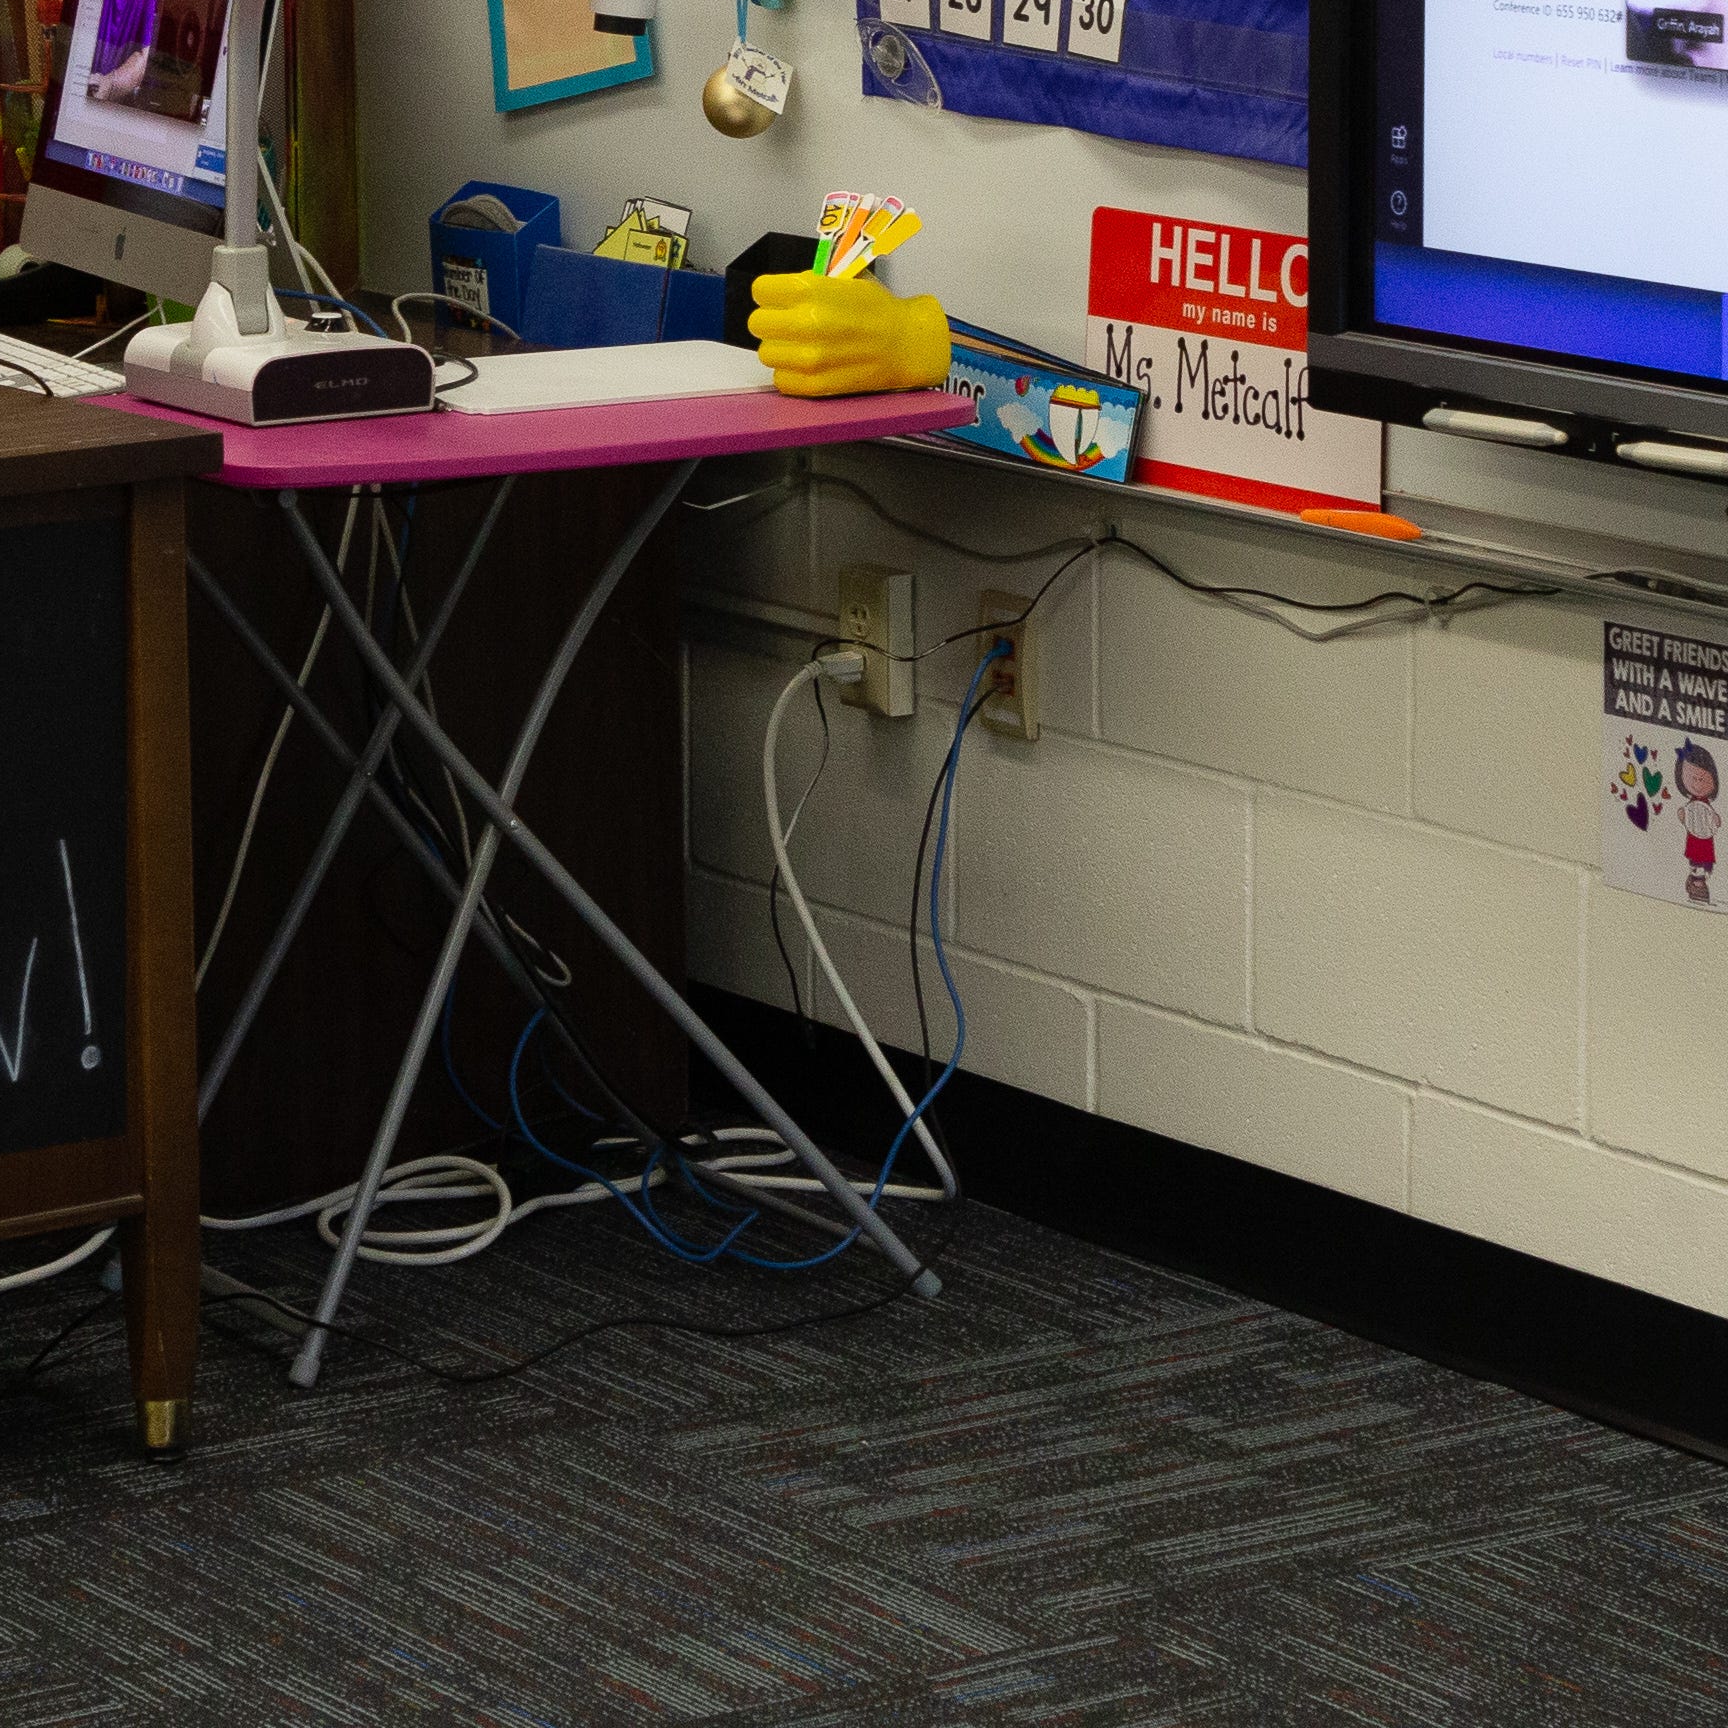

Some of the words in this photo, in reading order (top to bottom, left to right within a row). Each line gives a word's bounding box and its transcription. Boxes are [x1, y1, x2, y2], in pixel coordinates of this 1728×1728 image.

[1182, 300, 1207, 325] my
[1212, 308, 1255, 330] name
[1262, 311, 1277, 330] is
[313, 376, 369, 389] ELMO
[1106, 323, 1162, 410] Ms.
[1174, 337, 1311, 441] Metcalf
[1609, 627, 1659, 651] GREET
[1612, 658, 1654, 686] WITH
[1659, 669, 1673, 688] A
[1677, 673, 1727, 702] WAVE
[1615, 690, 1653, 717] AND
[1658, 699, 1672, 719] A
[1675, 704, 1726, 731] SMILE
